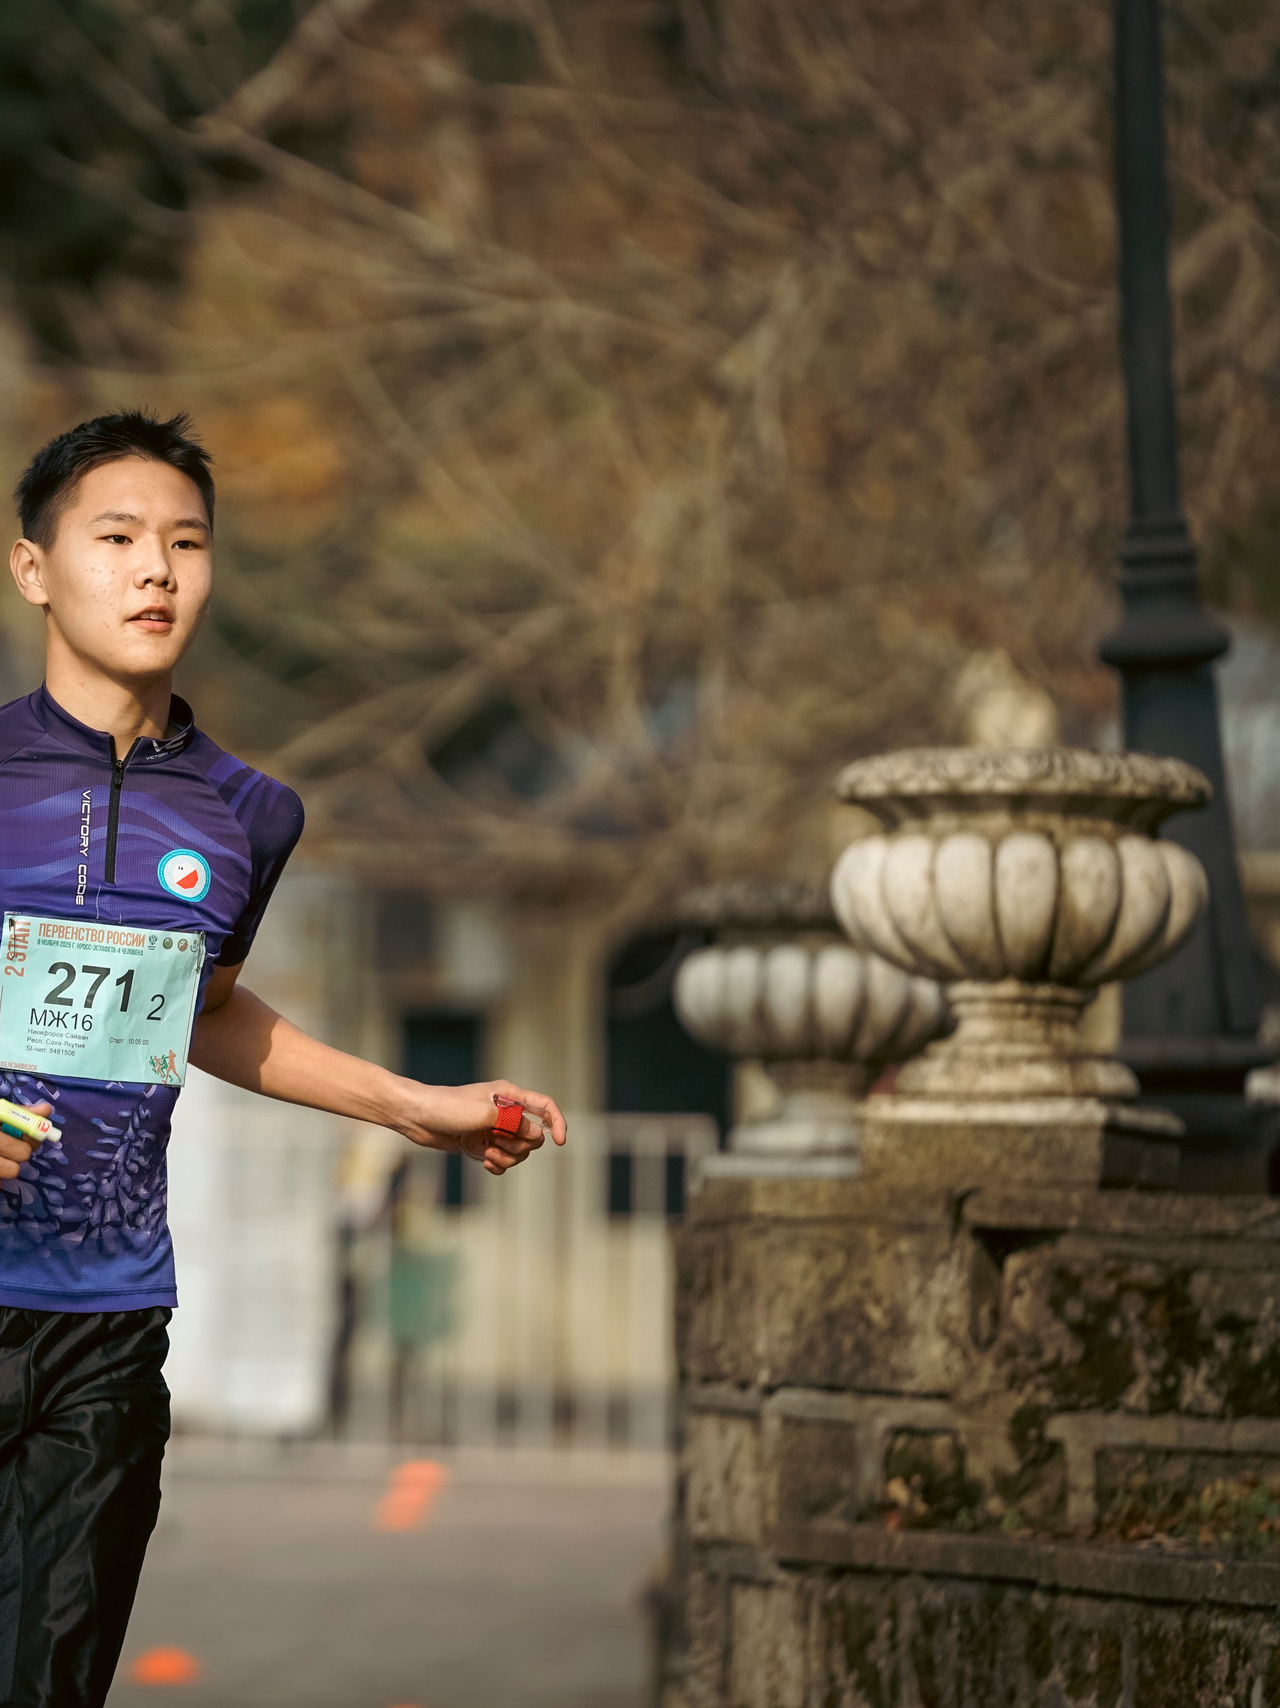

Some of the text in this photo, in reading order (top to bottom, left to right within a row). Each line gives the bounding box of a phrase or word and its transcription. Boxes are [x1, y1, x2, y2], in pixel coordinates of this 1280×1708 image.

[146, 752, 168, 760] VICTORY
[75, 789, 91, 906] VICTORY CODE
[38, 923, 146, 948] ПЕРВЕНСТВО РОССИИ
[41, 939, 59, 947] НОЯБРЯ
[60, 941, 71, 949] 2025
[121, 947, 144, 956] ЧЕЛОВЕКА
[4, 965, 24, 977] 2
[44, 962, 135, 1012] 271
[146, 994, 166, 1021] 2
[30, 1008, 93, 1031] МЖ16
[27, 1029, 64, 1038] Никифоров
[109, 1036, 124, 1044] Старт
[45, 1039, 86, 1049] Саха-Якутия
[49, 1048, 76, 1056] 8481506
